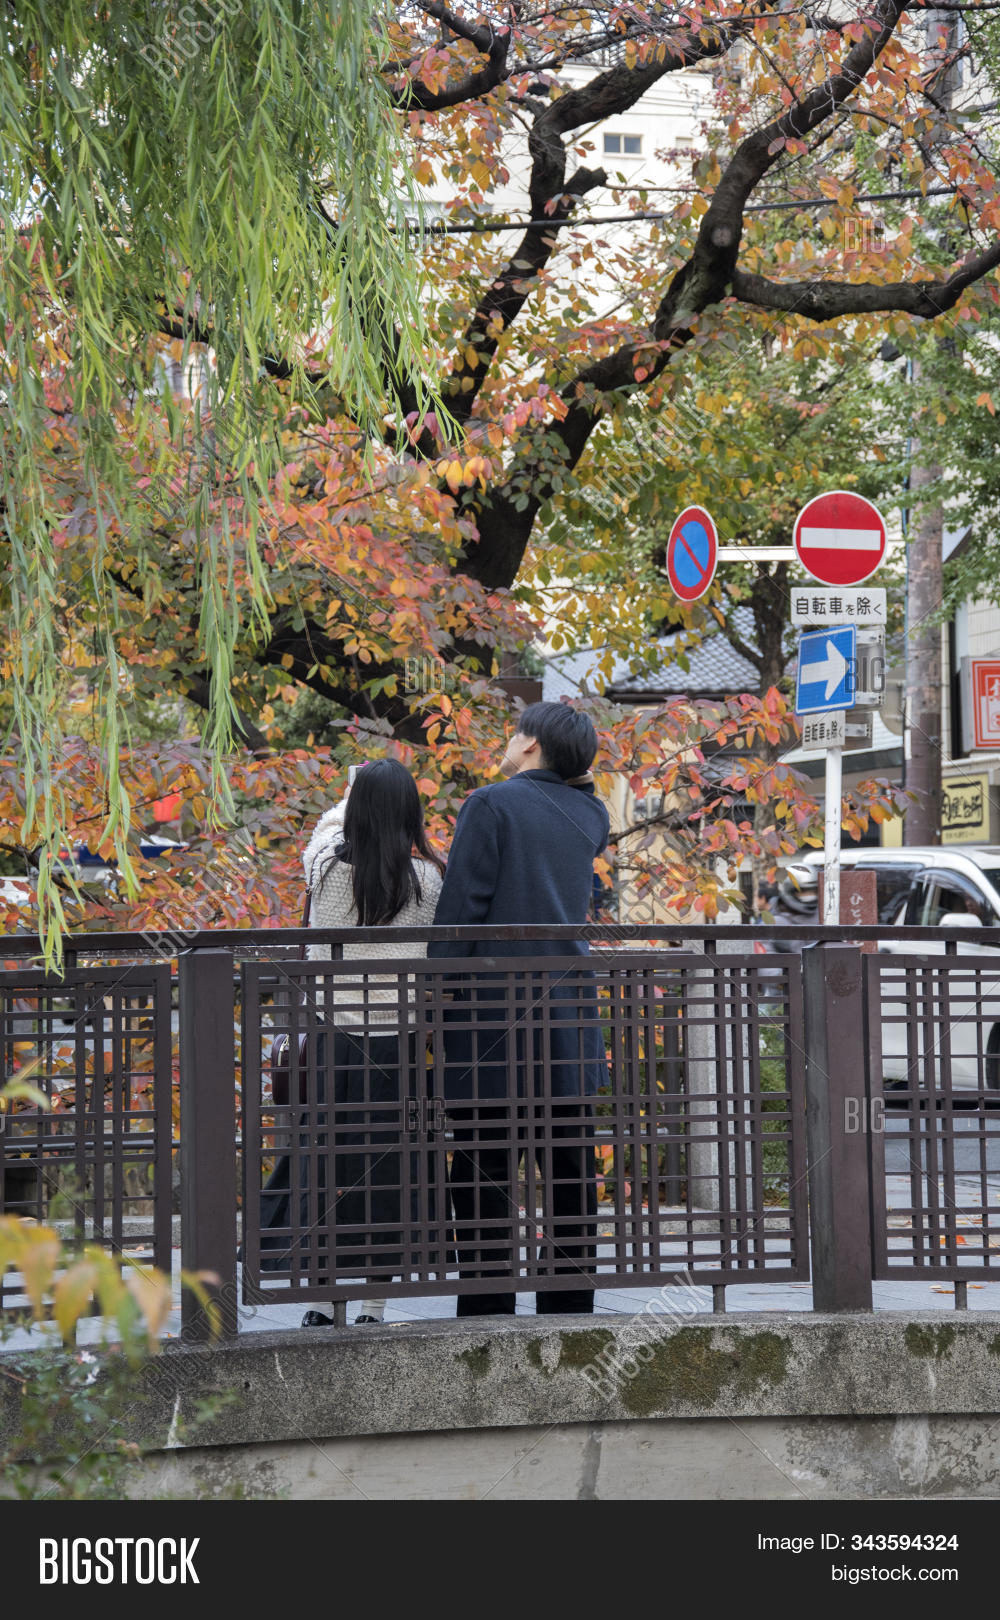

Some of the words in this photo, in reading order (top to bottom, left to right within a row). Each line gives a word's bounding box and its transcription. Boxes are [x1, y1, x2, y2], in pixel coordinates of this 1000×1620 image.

[796, 597, 882, 615] 自転車を除く
